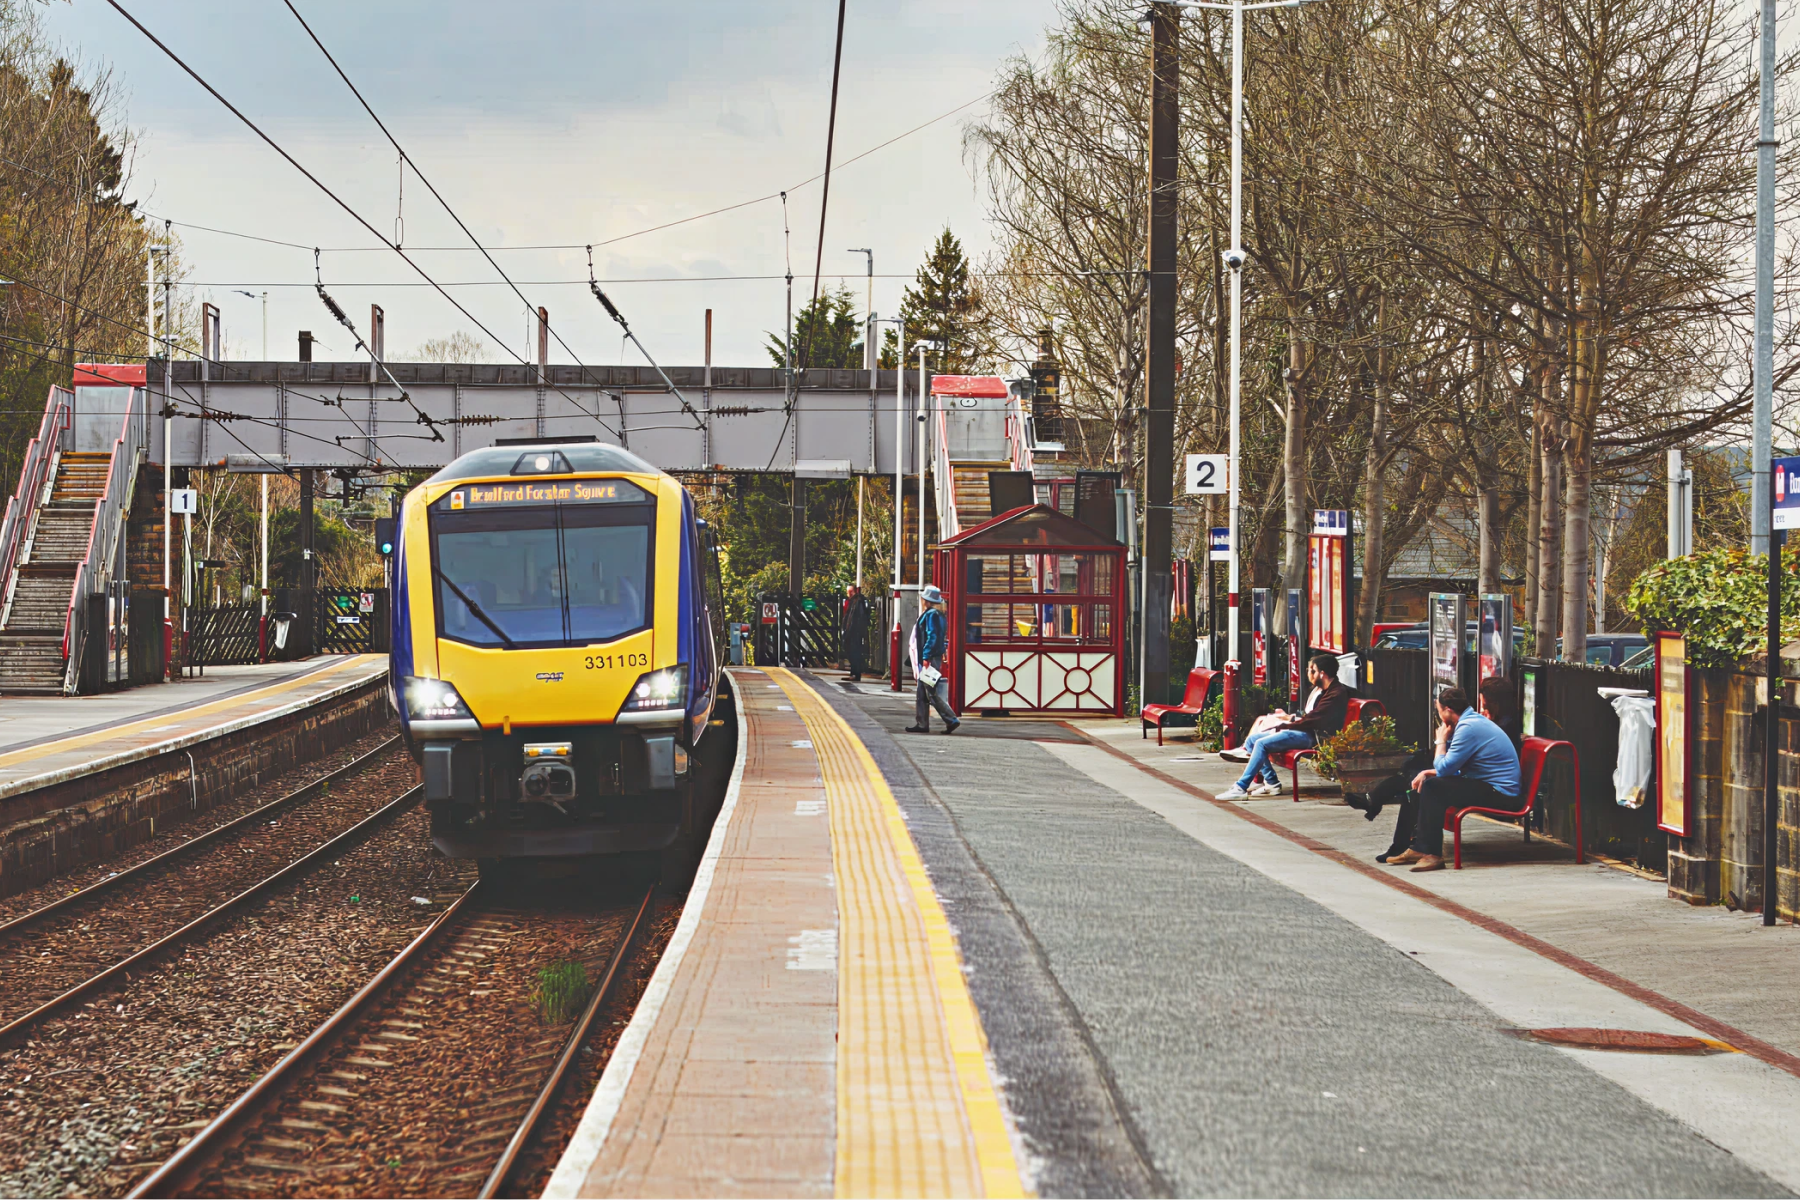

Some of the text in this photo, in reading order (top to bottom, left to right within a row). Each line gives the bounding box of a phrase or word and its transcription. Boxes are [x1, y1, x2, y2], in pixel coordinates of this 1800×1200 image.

[1197, 461, 1215, 487] 2
[574, 484, 615, 499] Square
[181, 493, 188, 509] 1
[585, 653, 648, 669] 331103
